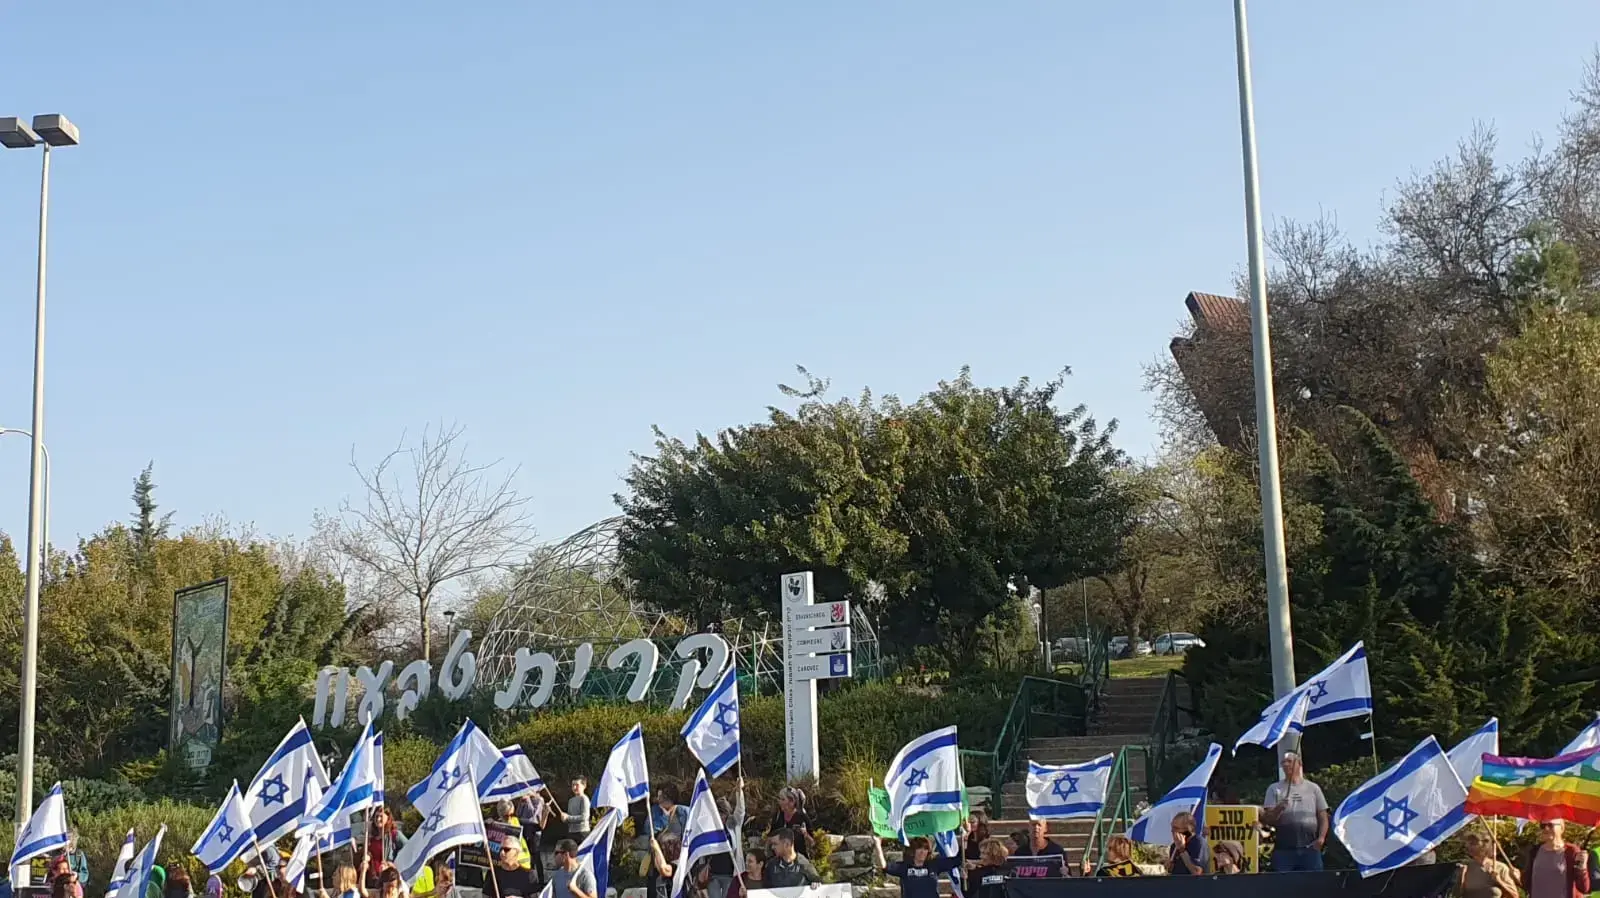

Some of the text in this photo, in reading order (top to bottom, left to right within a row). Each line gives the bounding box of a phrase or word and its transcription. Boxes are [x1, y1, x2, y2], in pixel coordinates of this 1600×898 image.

[494, 633, 730, 711] קרית
[1219, 810, 1244, 824] טוב
[1210, 823, 1254, 840] למחות
